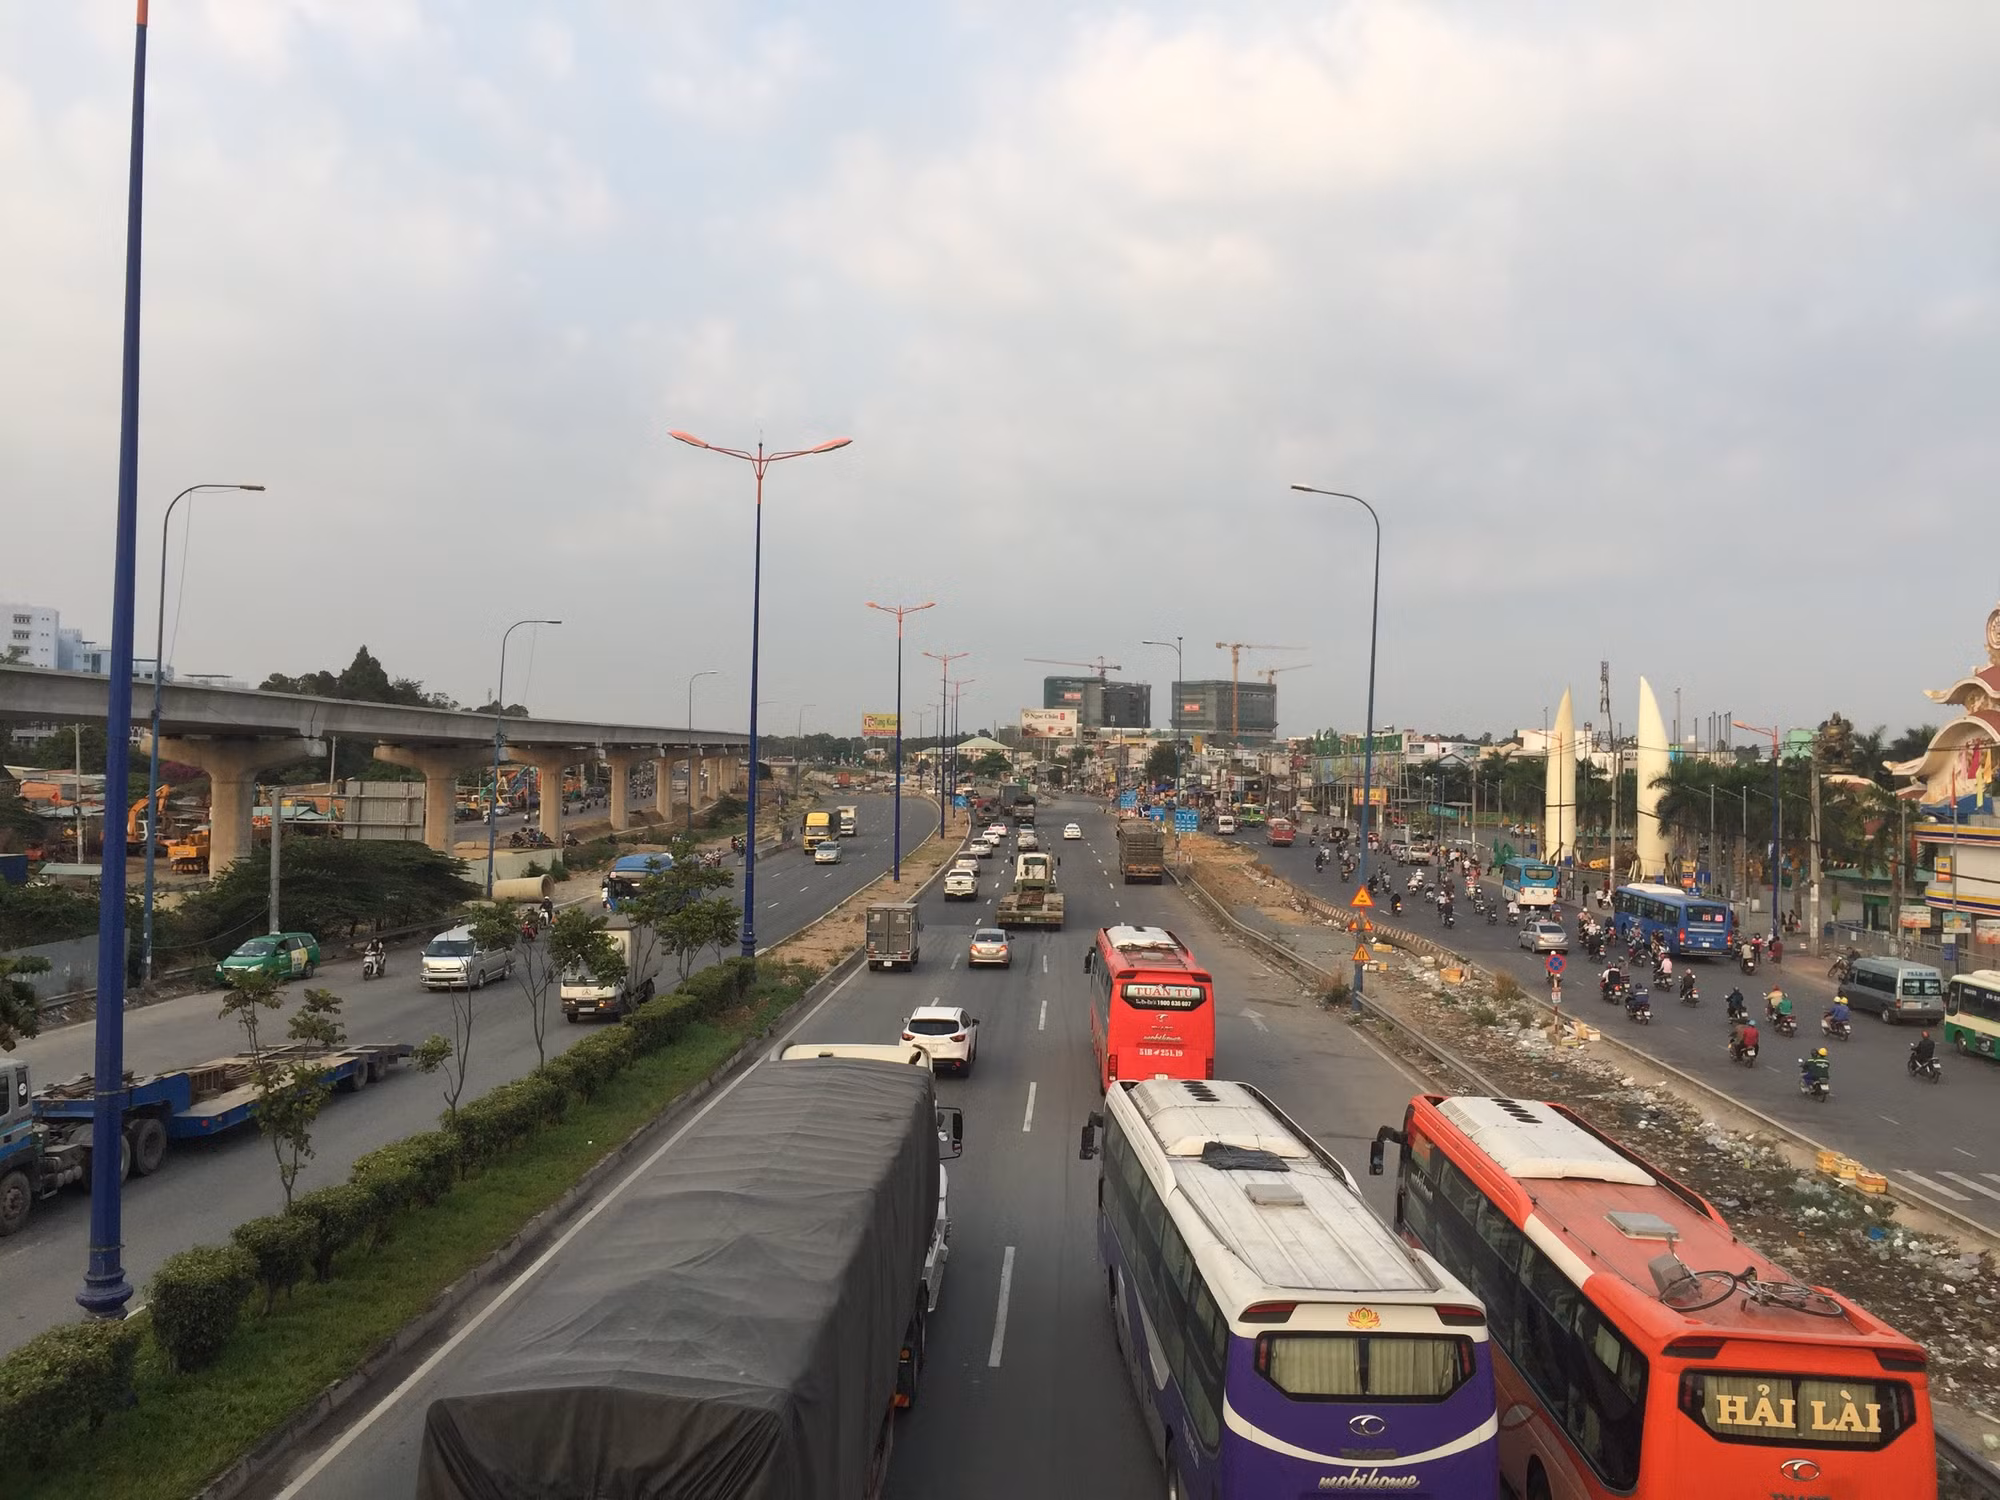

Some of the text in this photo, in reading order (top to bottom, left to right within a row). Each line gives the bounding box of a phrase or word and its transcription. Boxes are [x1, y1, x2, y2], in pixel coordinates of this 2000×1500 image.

[1716, 1383, 1882, 1433] HẢI LÀI
[1318, 1468, 1421, 1489] mobihome
